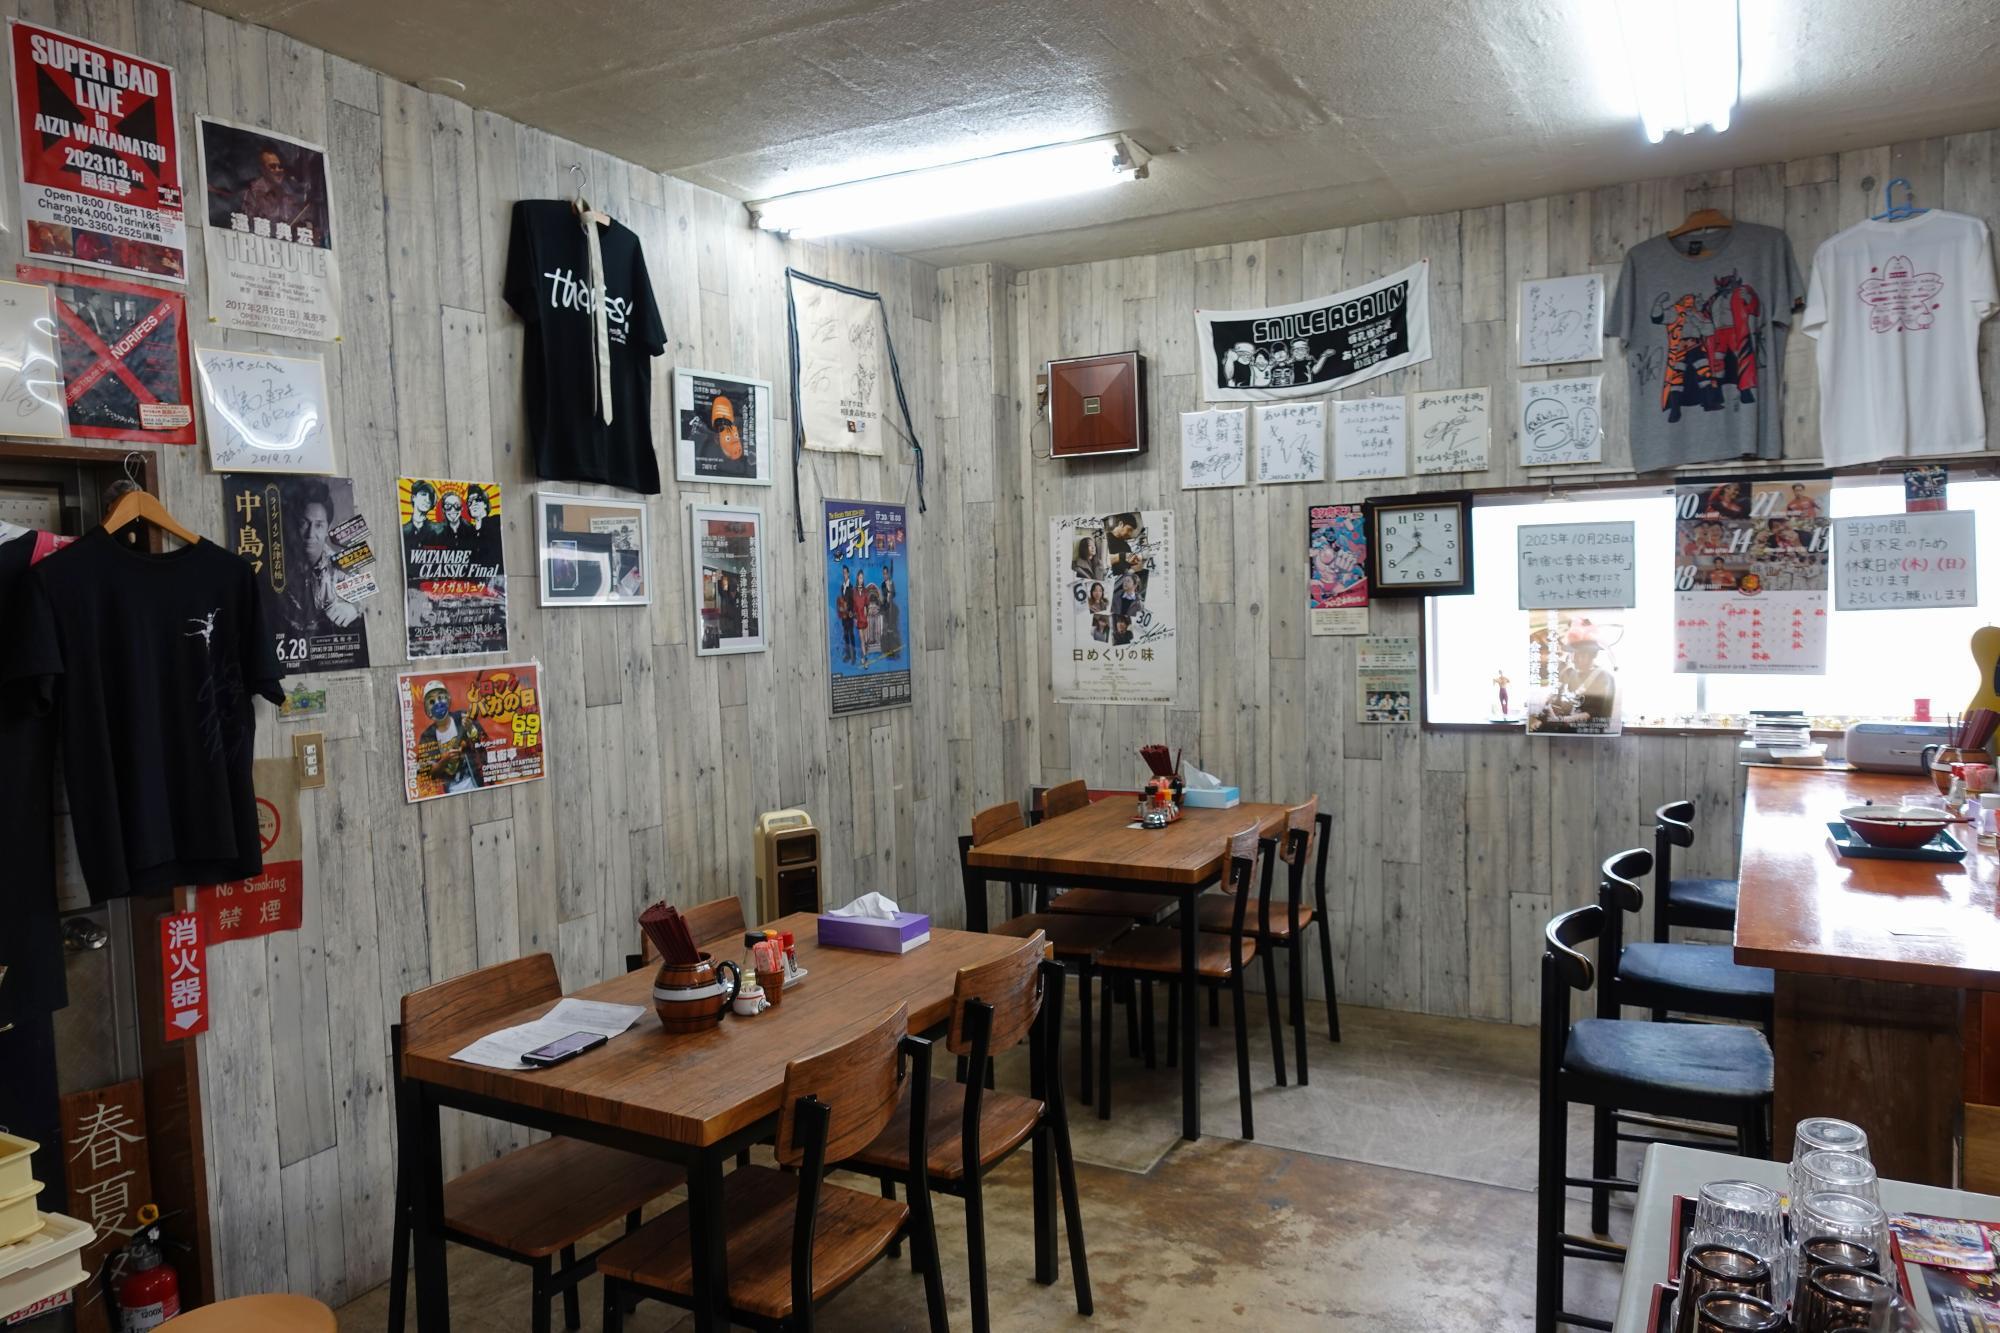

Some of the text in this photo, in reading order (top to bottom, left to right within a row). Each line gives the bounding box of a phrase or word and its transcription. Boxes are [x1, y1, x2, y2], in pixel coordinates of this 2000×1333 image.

[30, 34, 159, 97] SUPER BAD
[74, 77, 124, 117] LIVE
[95, 110, 109, 130] in
[34, 113, 167, 163] AIZU WAKAMATSU
[81, 171, 132, 197] 風街亭
[131, 169, 144, 183] fri
[44, 187, 72, 203] Open
[75, 191, 104, 209] 18:00
[114, 203, 138, 218] Start
[221, 232, 327, 279] TRIBUTE
[1252, 314, 1328, 344] SMILE
[1328, 283, 1405, 332] AGAIN
[111, 315, 159, 360] NORIFES
[1676, 493, 1699, 520] 10
[1398, 516, 1407, 524] 11
[1413, 512, 1425, 521] 12
[1434, 514, 1438, 522] 1
[829, 517, 871, 551] ロカビリー
[1386, 527, 1397, 536] 10
[1444, 524, 1452, 532] 2
[1447, 541, 1455, 549] 3
[1525, 532, 1633, 547] 2025年10月25日(土)
[1730, 528, 1754, 554] 14
[1847, 538, 1948, 553] 人員不足のため
[1385, 544, 1393, 552] 9
[410, 550, 472, 564] WATANABE
[1146, 556, 1156, 570] 4
[1388, 560, 1397, 569] 8
[1444, 557, 1452, 566] 4
[419, 563, 499, 578] CLASSIC Final
[1401, 571, 1408, 579] 7
[1417, 571, 1425, 579] 6
[1434, 568, 1442, 577] 5
[1675, 565, 1698, 591] 18
[431, 581, 486, 593] タイガ&リュウ
[1847, 575, 1910, 587] になります
[1073, 583, 1088, 602] 6
[1849, 589, 1967, 605] よろしくお願いします
[1136, 610, 1152, 627] 30
[276, 638, 308, 661] 6.28
[1073, 648, 1155, 663] 日めくりの味
[479, 674, 519, 695] ロック
[469, 688, 537, 720] バカの日
[215, 875, 287, 898] No Smoking
[218, 898, 281, 931] 禁煙
[167, 915, 202, 1010] 消火器
[8, 1291, 69, 1323] ロックアイス
[141, 1305, 164, 1320] 1200X
